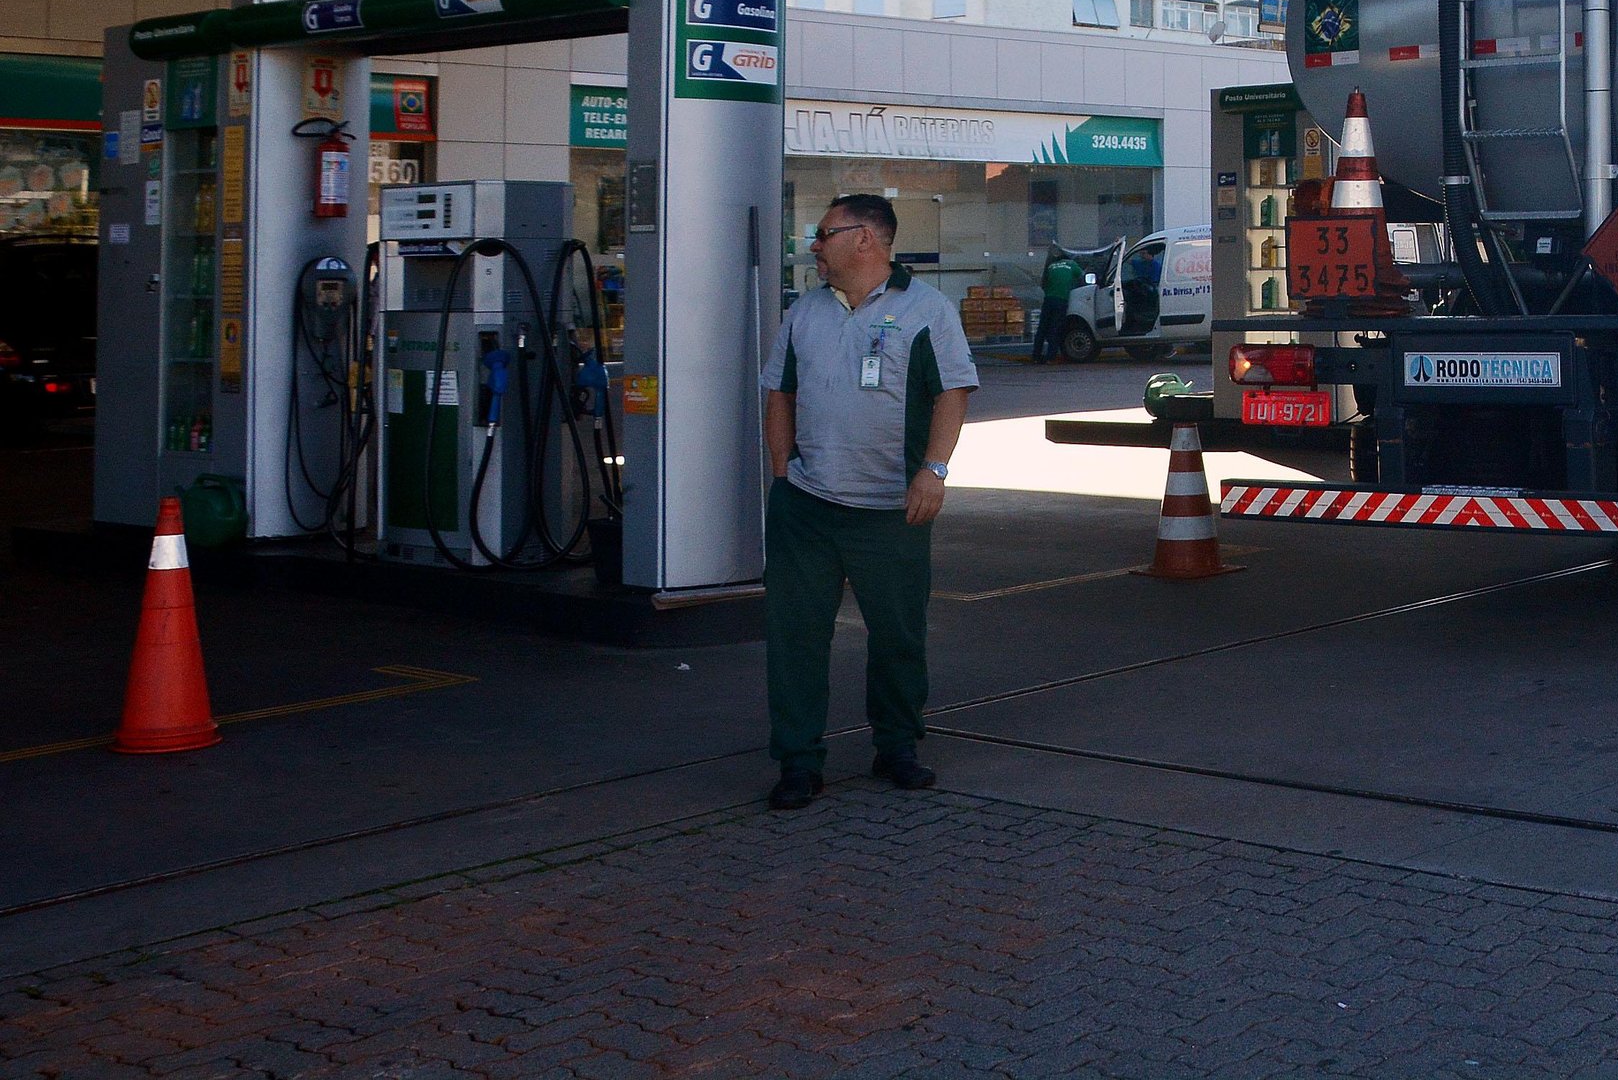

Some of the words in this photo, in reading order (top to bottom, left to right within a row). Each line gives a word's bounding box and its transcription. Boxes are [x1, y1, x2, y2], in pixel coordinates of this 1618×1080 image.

[737, 3, 775, 19] Gasolina
[692, 44, 714, 71] G
[733, 51, 775, 69] GRID
[1225, 94, 1243, 102] Posto
[1092, 134, 1146, 151] 3249.4435
[1316, 226, 1349, 255] 33
[1298, 264, 1369, 294] 3475
[1436, 356, 1554, 378] RODOTÉCNICA
